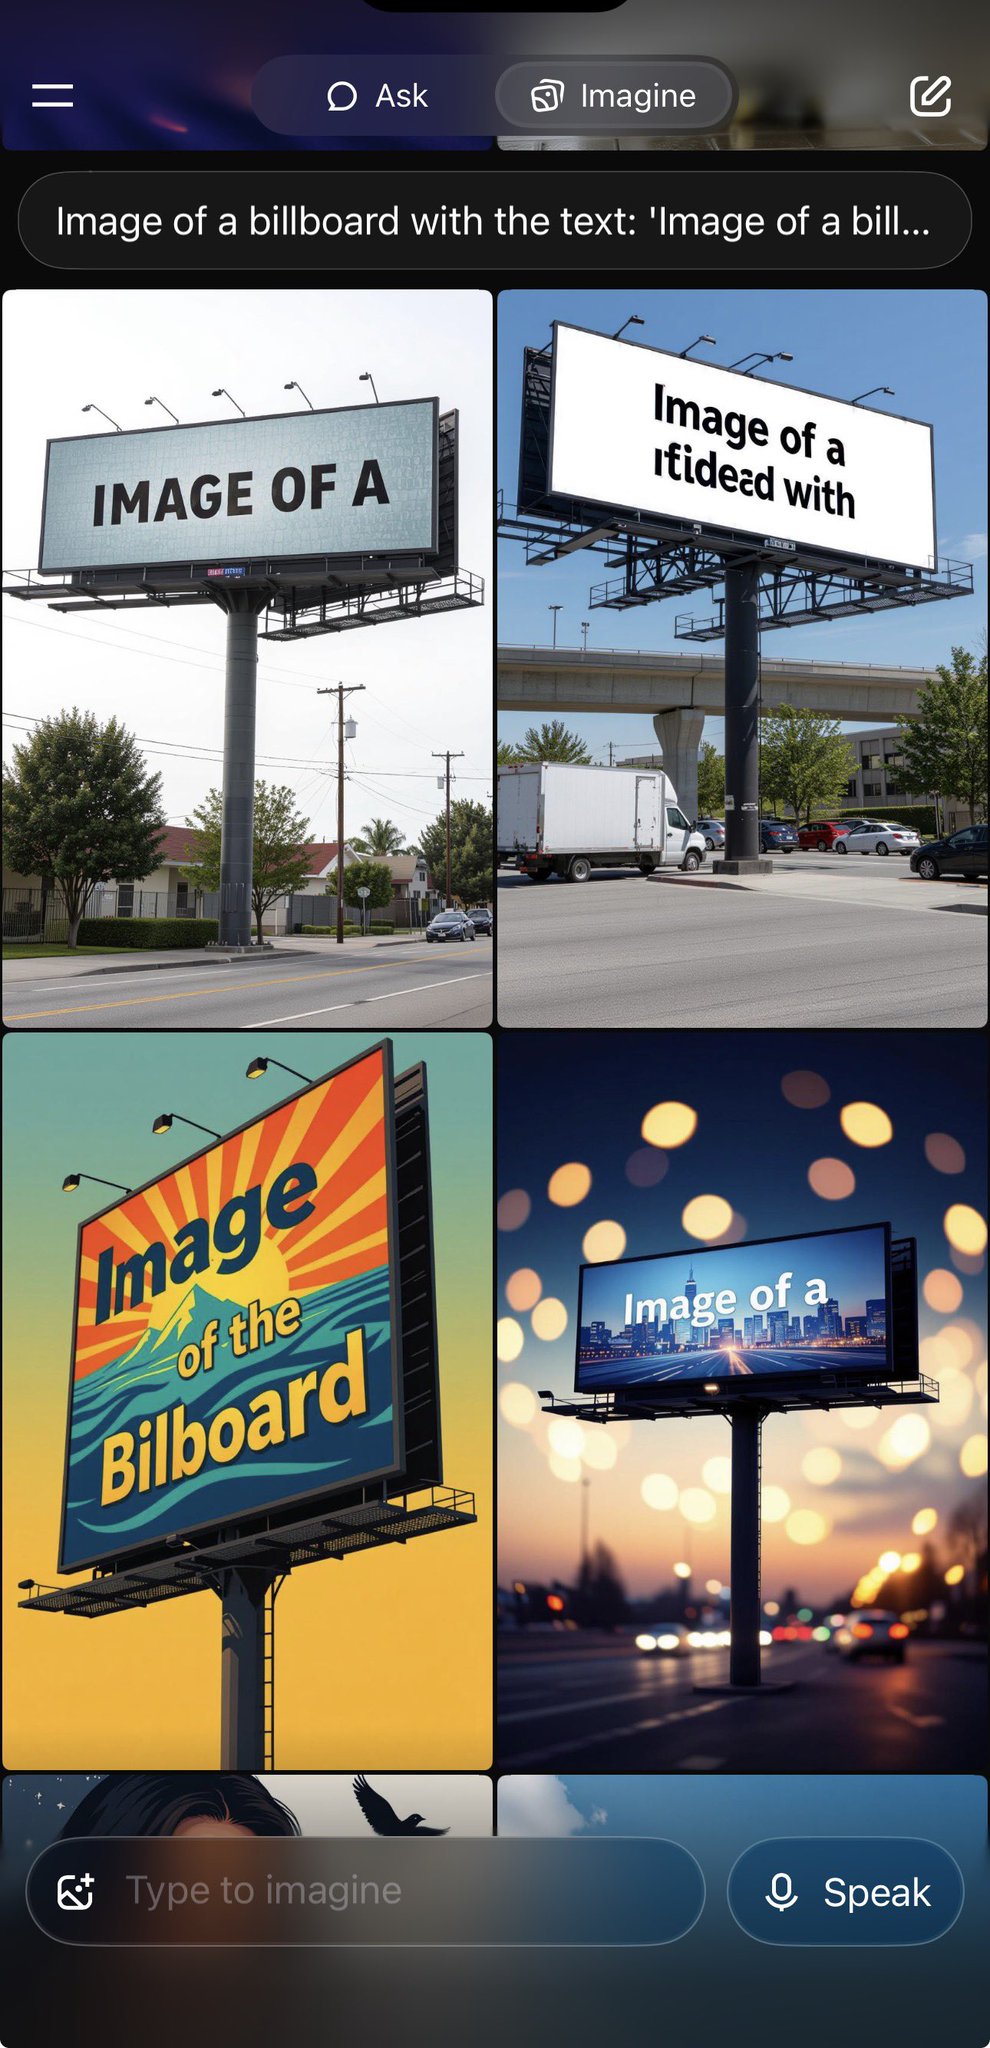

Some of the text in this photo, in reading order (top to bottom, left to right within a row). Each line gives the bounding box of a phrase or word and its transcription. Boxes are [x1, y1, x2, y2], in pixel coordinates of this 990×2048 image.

[375, 82, 429, 108] Ask
[581, 82, 696, 114] Imagine
[58, 206, 163, 243] Image
[174, 205, 208, 236] of
[218, 212, 237, 236] a
[251, 204, 399, 236] billboard
[411, 204, 482, 236] with
[493, 205, 550, 236] the
[560, 207, 636, 236] text:
[650, 206, 765, 243] 'Image
[777, 204, 810, 236] of
[821, 212, 840, 236] a
[654, 383, 846, 467] Image of a
[93, 459, 390, 527] IMAGE OF A
[783, 475, 855, 520] with
[95, 1161, 318, 1327] Image
[624, 1271, 829, 1327] Image of a
[176, 1297, 302, 1379] of the
[100, 1326, 369, 1509] Bilboard
[125, 1873, 402, 1912] Type to imagine
[824, 1876, 932, 1914] Speak
